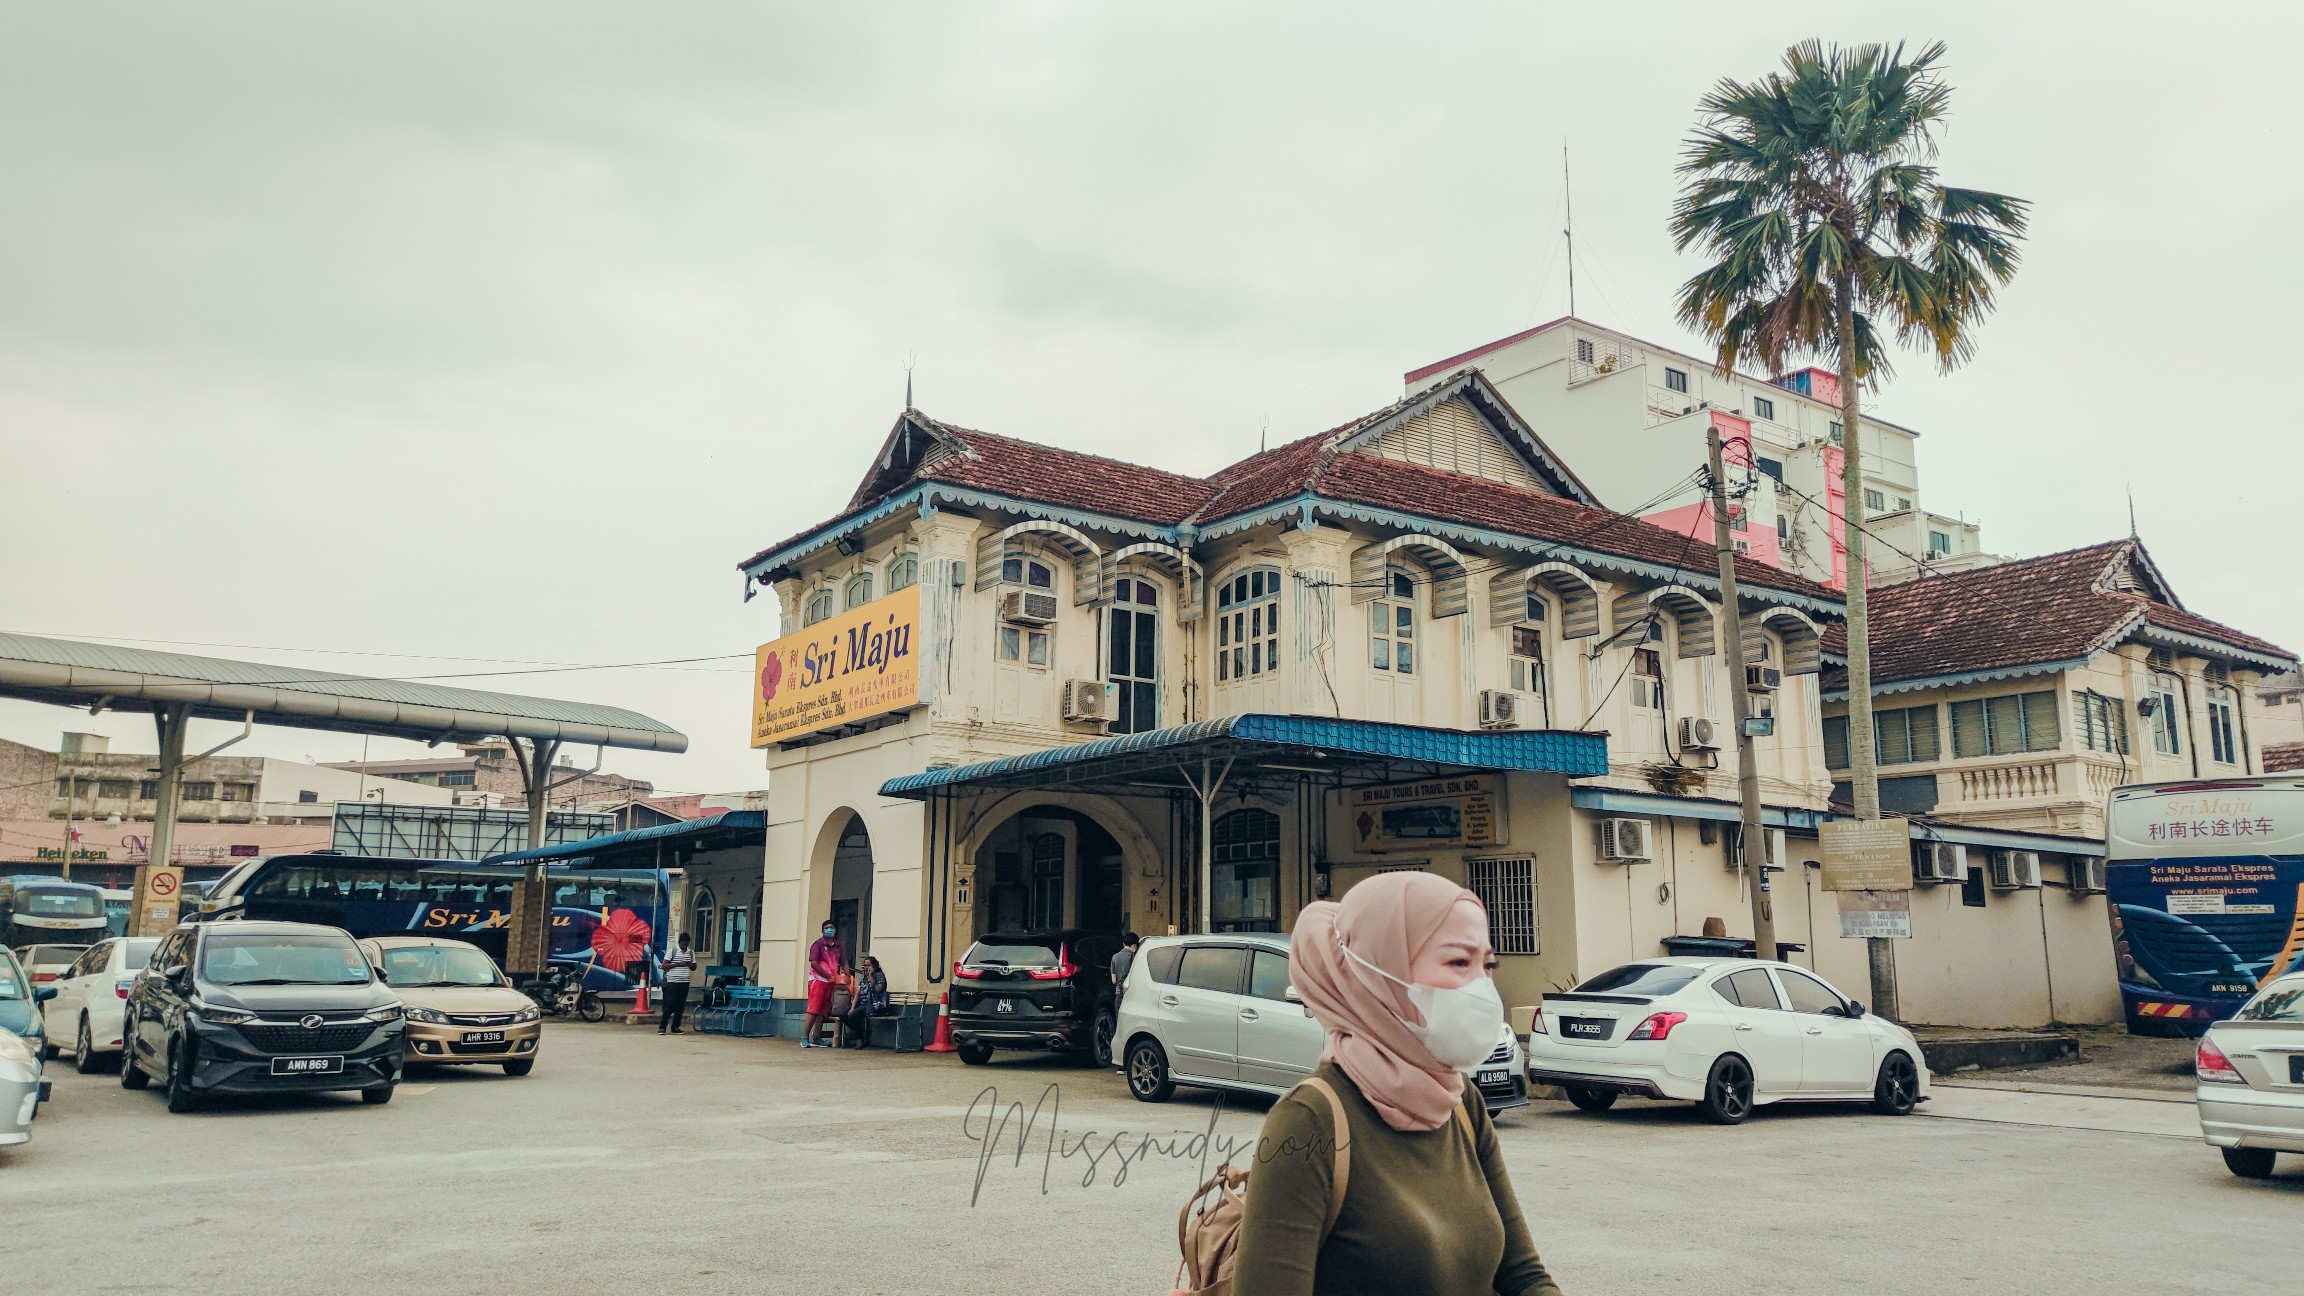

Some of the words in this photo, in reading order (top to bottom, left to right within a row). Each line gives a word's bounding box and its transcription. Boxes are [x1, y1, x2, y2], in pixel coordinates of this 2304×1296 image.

[800, 635, 838, 689] Sri
[842, 613, 911, 675] Maju
[758, 711, 766, 725] Sri
[766, 709, 778, 723] Maju
[779, 705, 795, 718] Sarata
[796, 700, 817, 714] Ekspres
[817, 694, 829, 707] Sdn.
[830, 689, 843, 704] Bhd.
[757, 725, 773, 738] Aneka
[773, 715, 800, 734] Jasaramai
[800, 711, 821, 726] Ekspres
[821, 707, 833, 720] Sdn.
[1363, 791, 1373, 801] SRI
[1374, 789, 1391, 800] MAJU
[1392, 787, 1413, 798] TOURS
[1415, 787, 1419, 796] &
[1421, 784, 1445, 795] TRAVEL
[1447, 782, 1462, 793] SDN.
[1464, 780, 1481, 791] BHD.
[2165, 801, 2196, 816] Sri
[2200, 798, 2253, 816] Maju
[2149, 817, 2274, 840] 利南长途快车
[2151, 866, 2164, 874] Sri
[2167, 866, 2191, 875] Maju
[2194, 865, 2227, 873] Sarata
[2231, 864, 2274, 873] Ekspres
[2151, 875, 2180, 883] Aneka
[2183, 873, 2232, 882] Jasaramai
[2234, 873, 2276, 882] Ekspres
[2170, 887, 2258, 896] www.srimaju.com
[424, 908, 480, 927] Sri
[481, 909, 571, 929] Mu
[467, 1034, 481, 1042] AHR
[287, 1060, 308, 1070] AMN
[309, 1060, 328, 1069] 869
